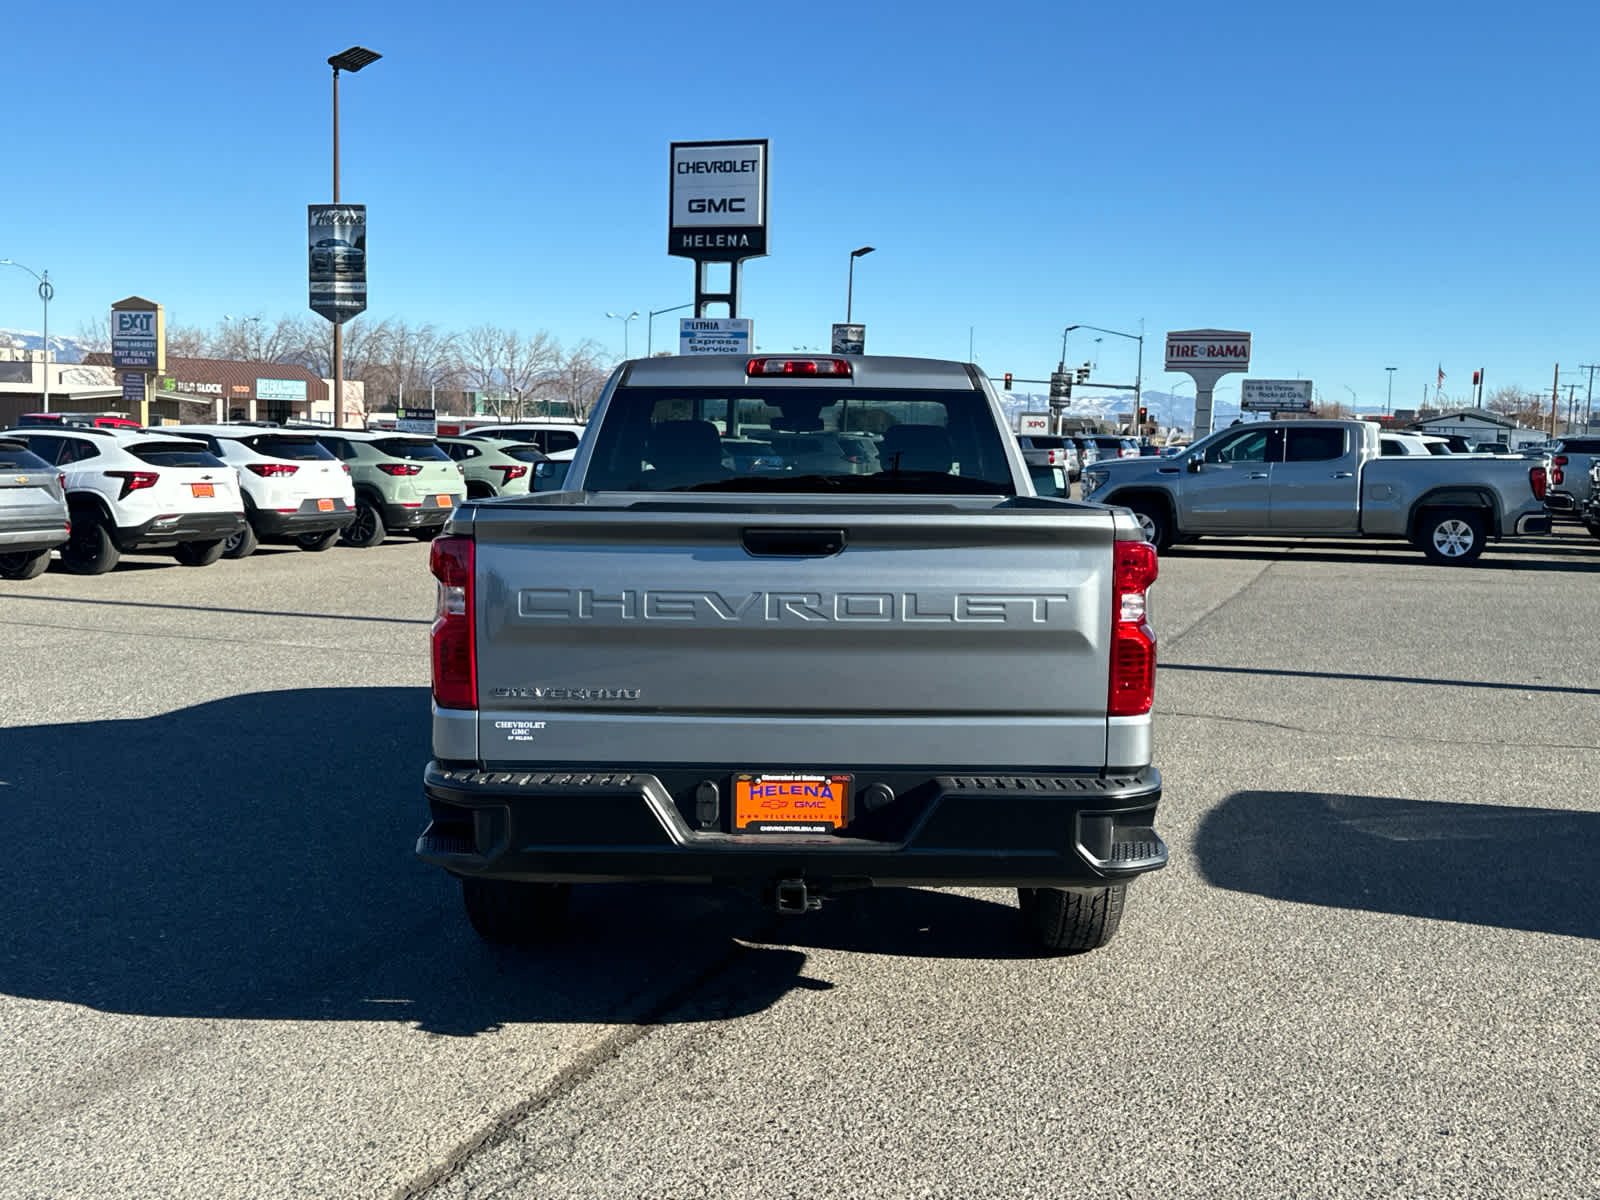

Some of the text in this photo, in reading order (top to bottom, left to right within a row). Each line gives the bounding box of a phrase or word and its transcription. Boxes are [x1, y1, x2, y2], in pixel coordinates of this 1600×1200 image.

[677, 160, 758, 174] CHEVROLET
[688, 198, 745, 213] GMC
[683, 234, 749, 247] HELENA
[691, 321, 719, 330] LITHIA
[688, 338, 740, 346] Express
[689, 345, 738, 353] Service
[1168, 344, 1198, 357] TIRE
[1207, 344, 1247, 357] RAMA
[196, 383, 223, 393] BLOCK
[517, 588, 1069, 622] CHEVROLET
[490, 687, 641, 700] SILVERADO
[495, 721, 547, 729] CHEVROLET
[750, 784, 834, 800] HELENA
